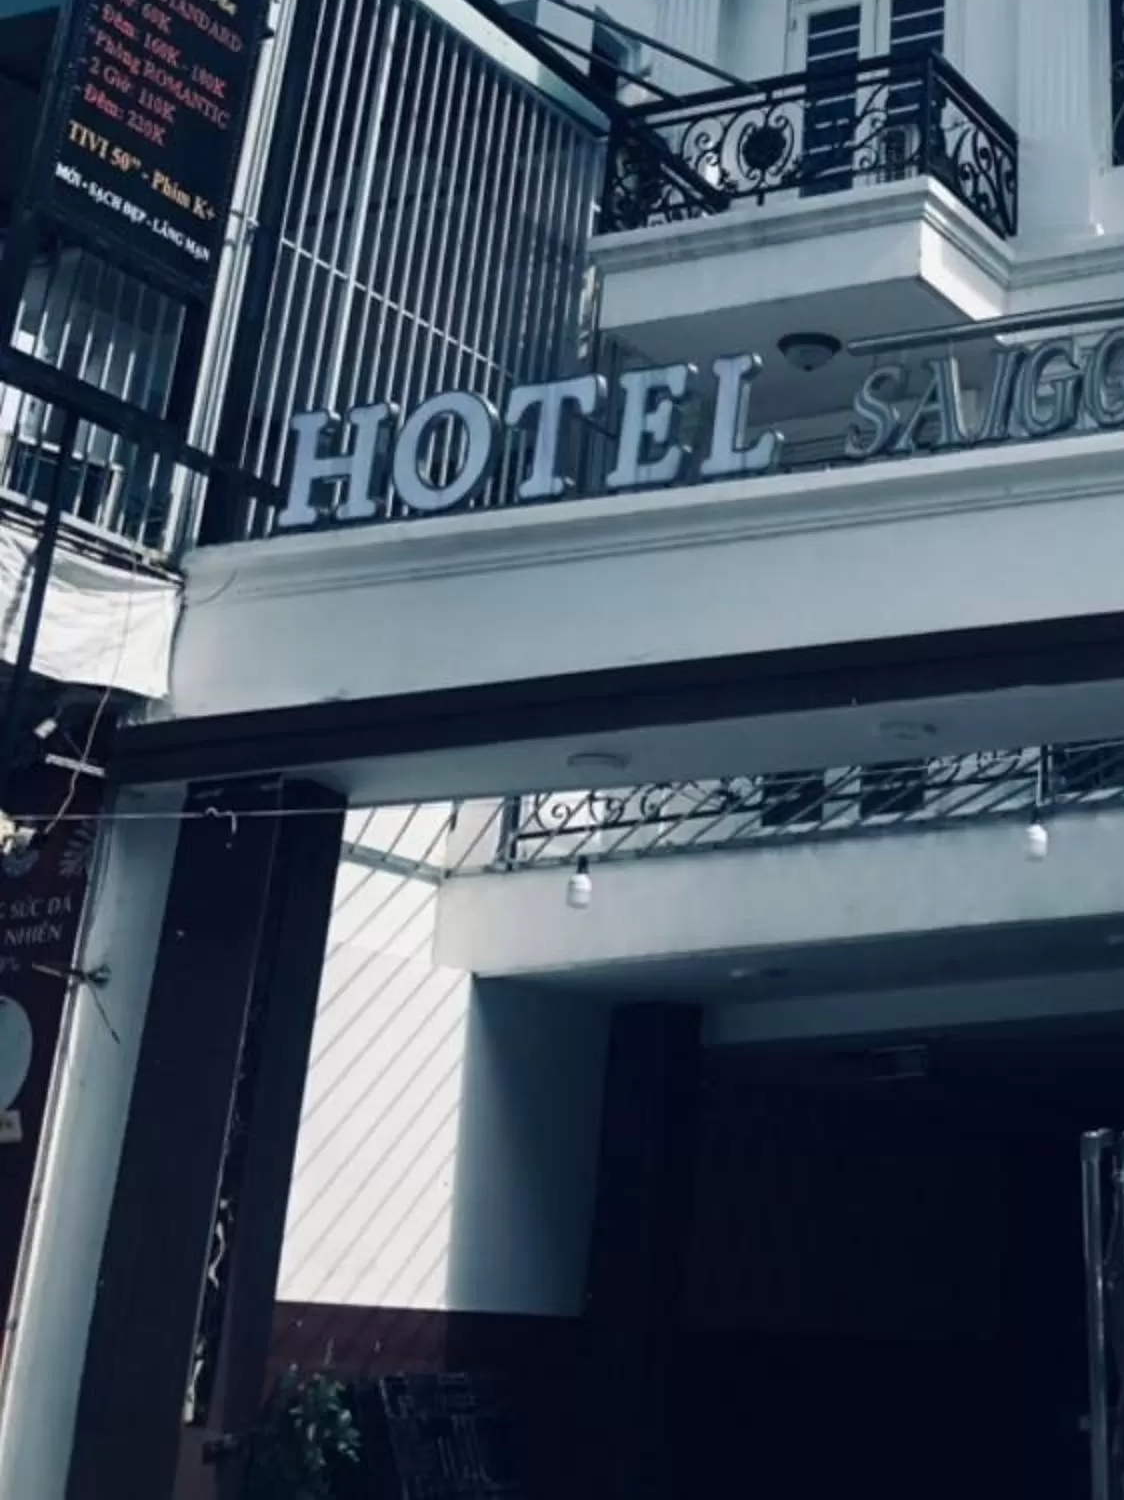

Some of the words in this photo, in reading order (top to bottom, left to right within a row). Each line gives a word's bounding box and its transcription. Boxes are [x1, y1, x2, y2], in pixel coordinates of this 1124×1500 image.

[142, 59, 231, 130] ROMANTIC
[67, 119, 110, 159] TIVI
[277, 352, 784, 527] HOTEL
